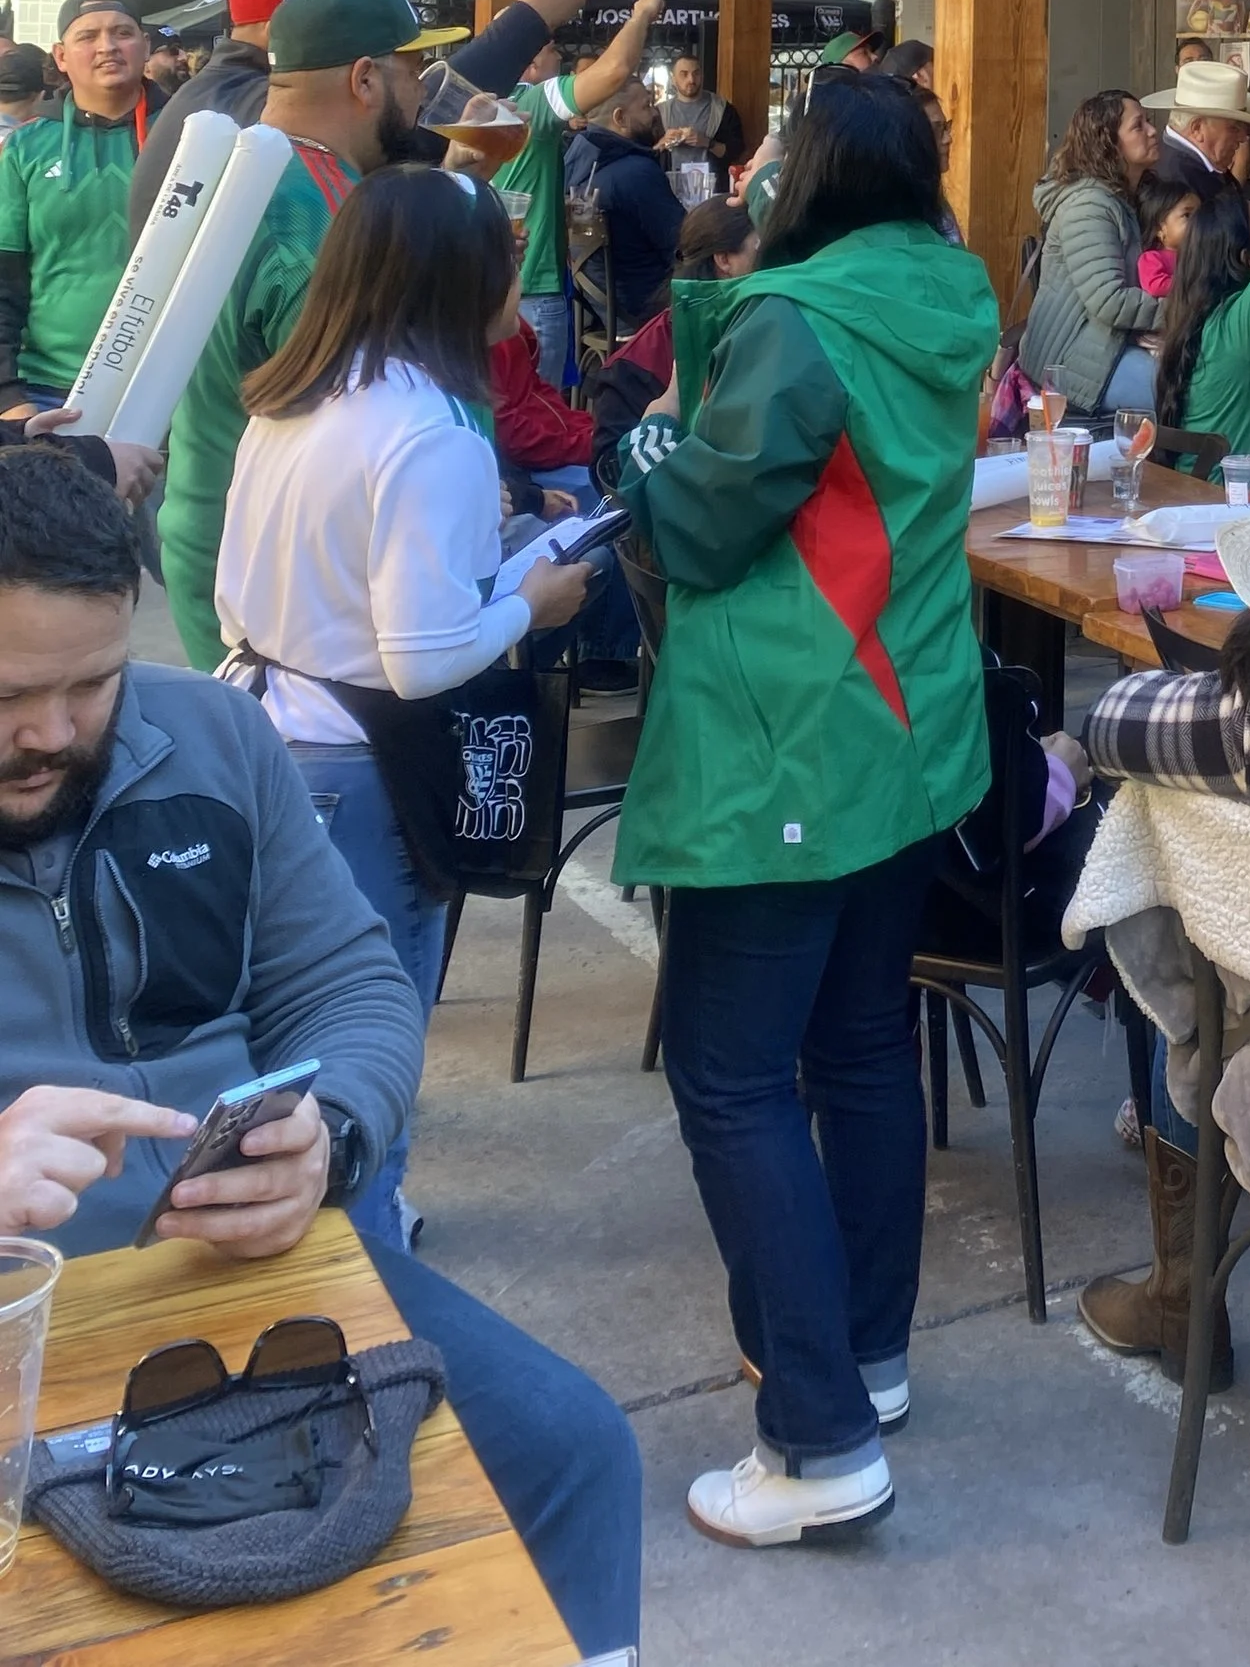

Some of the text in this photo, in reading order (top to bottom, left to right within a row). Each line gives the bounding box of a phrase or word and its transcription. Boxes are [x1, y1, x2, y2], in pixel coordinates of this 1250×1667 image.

[131, 256, 144, 273] se
[115, 277, 135, 308] vive
[130, 293, 155, 315] El
[104, 312, 119, 330] en
